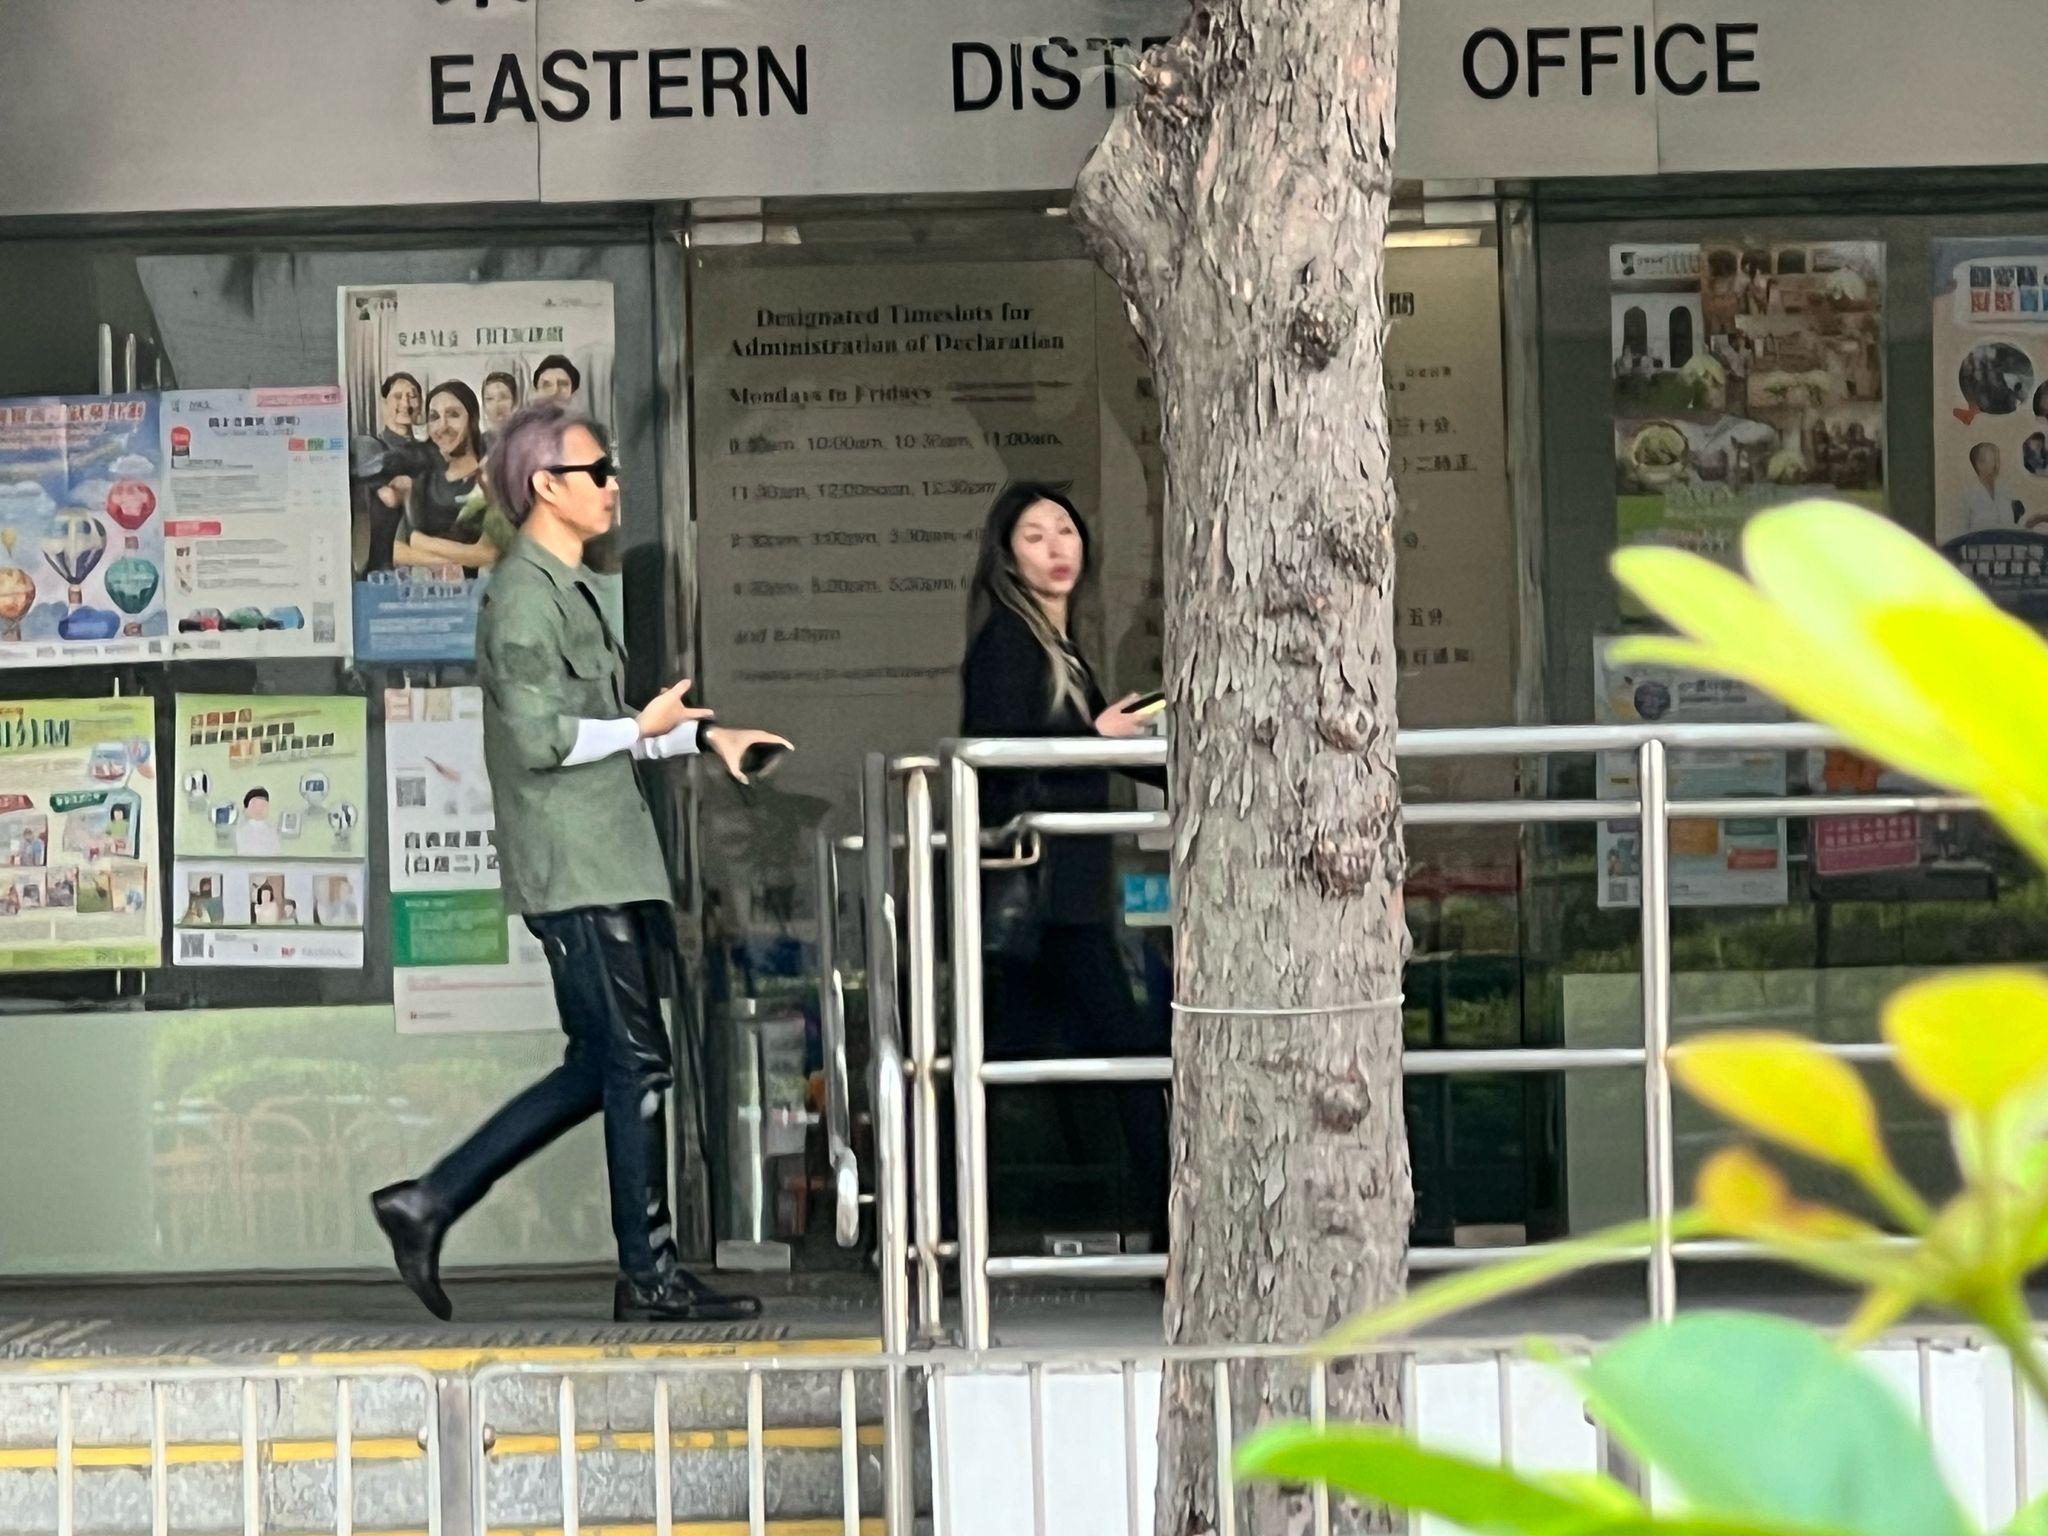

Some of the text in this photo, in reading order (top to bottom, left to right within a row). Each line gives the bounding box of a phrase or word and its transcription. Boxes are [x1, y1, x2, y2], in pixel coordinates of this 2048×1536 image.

[430, 23, 1761, 125] EASTERN DIST OFFICE
[757, 302, 1034, 328] Designated Timeslots for
[732, 332, 1064, 357] Administration of Declaration
[728, 386, 822, 406] Mondays
[828, 388, 847, 402] to
